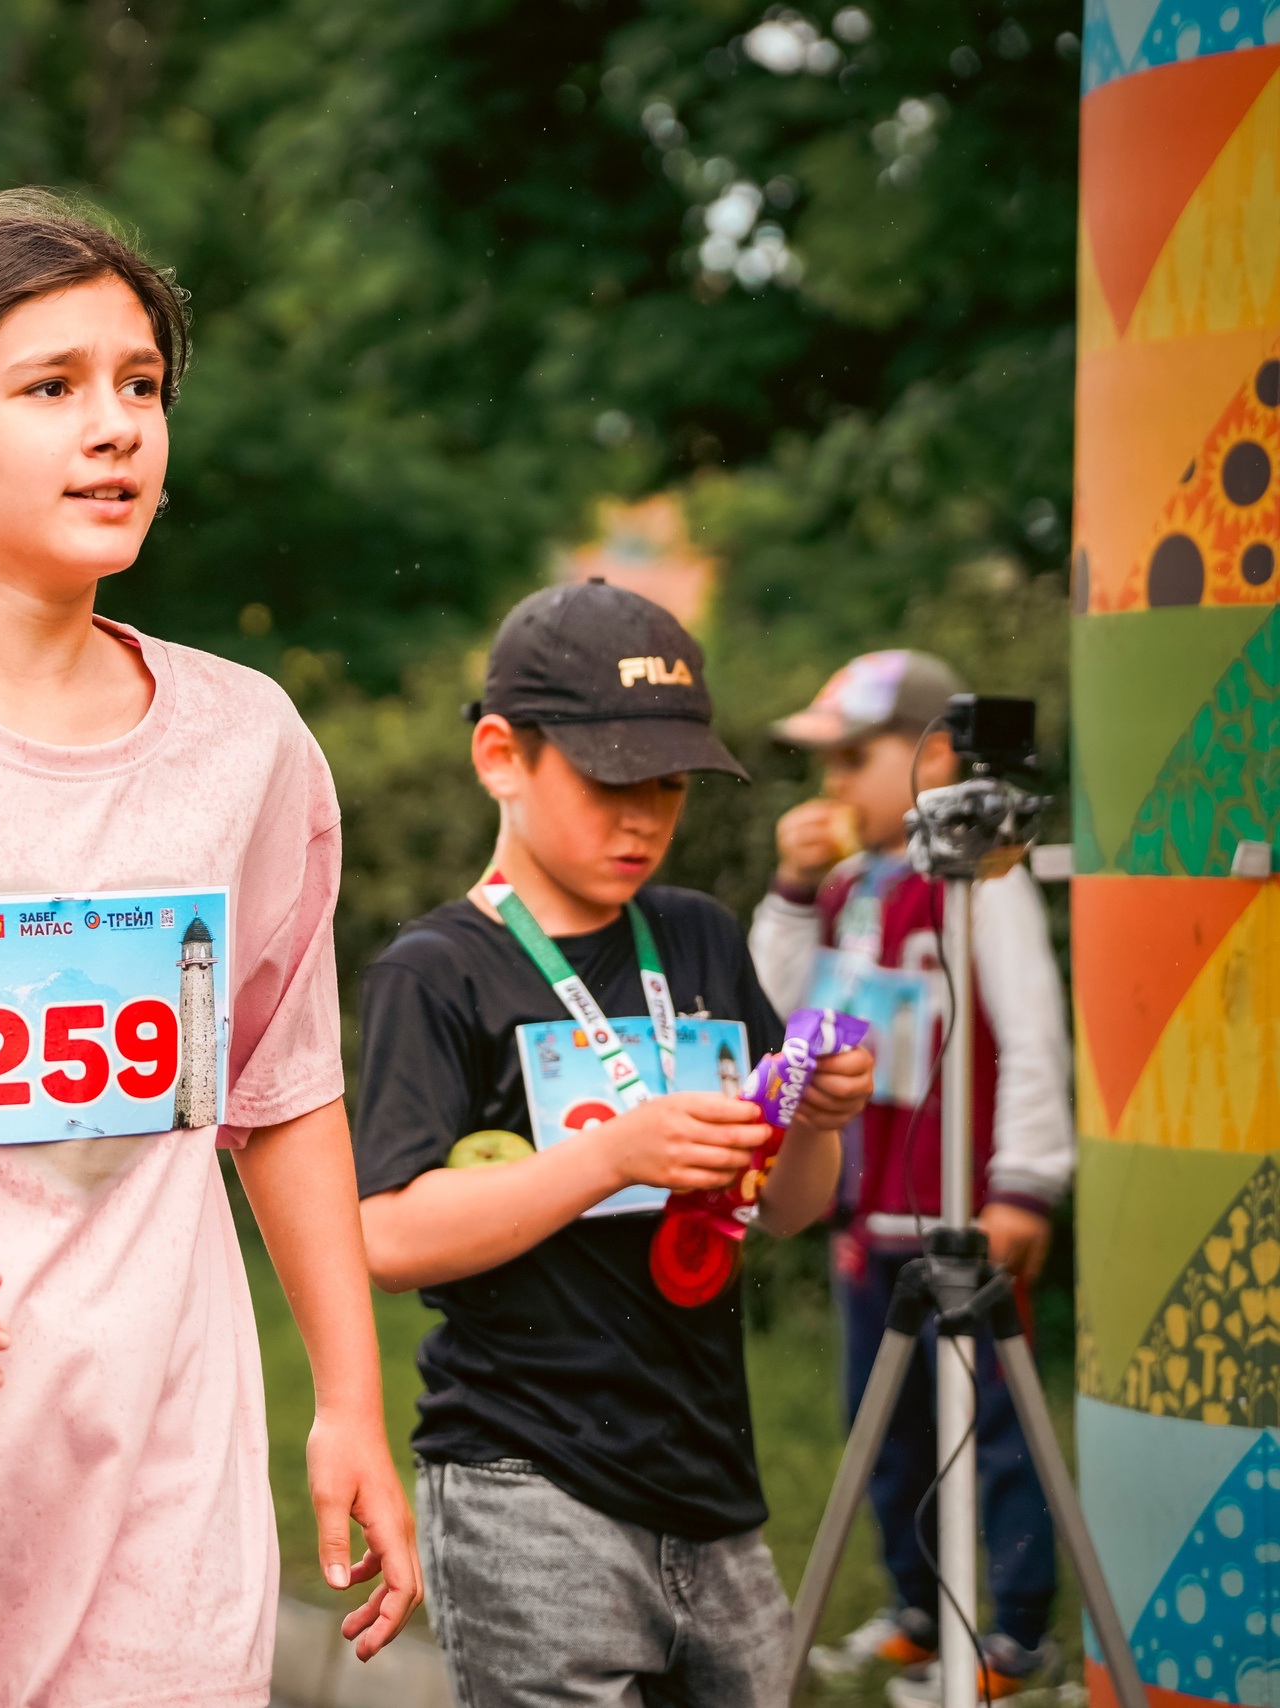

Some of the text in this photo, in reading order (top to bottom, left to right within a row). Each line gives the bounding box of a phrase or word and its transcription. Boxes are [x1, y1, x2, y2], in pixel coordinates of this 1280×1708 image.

[618, 656, 693, 688] FILA
[20, 911, 56, 923] ЗАБЕГ
[20, 921, 73, 937] МАГАС
